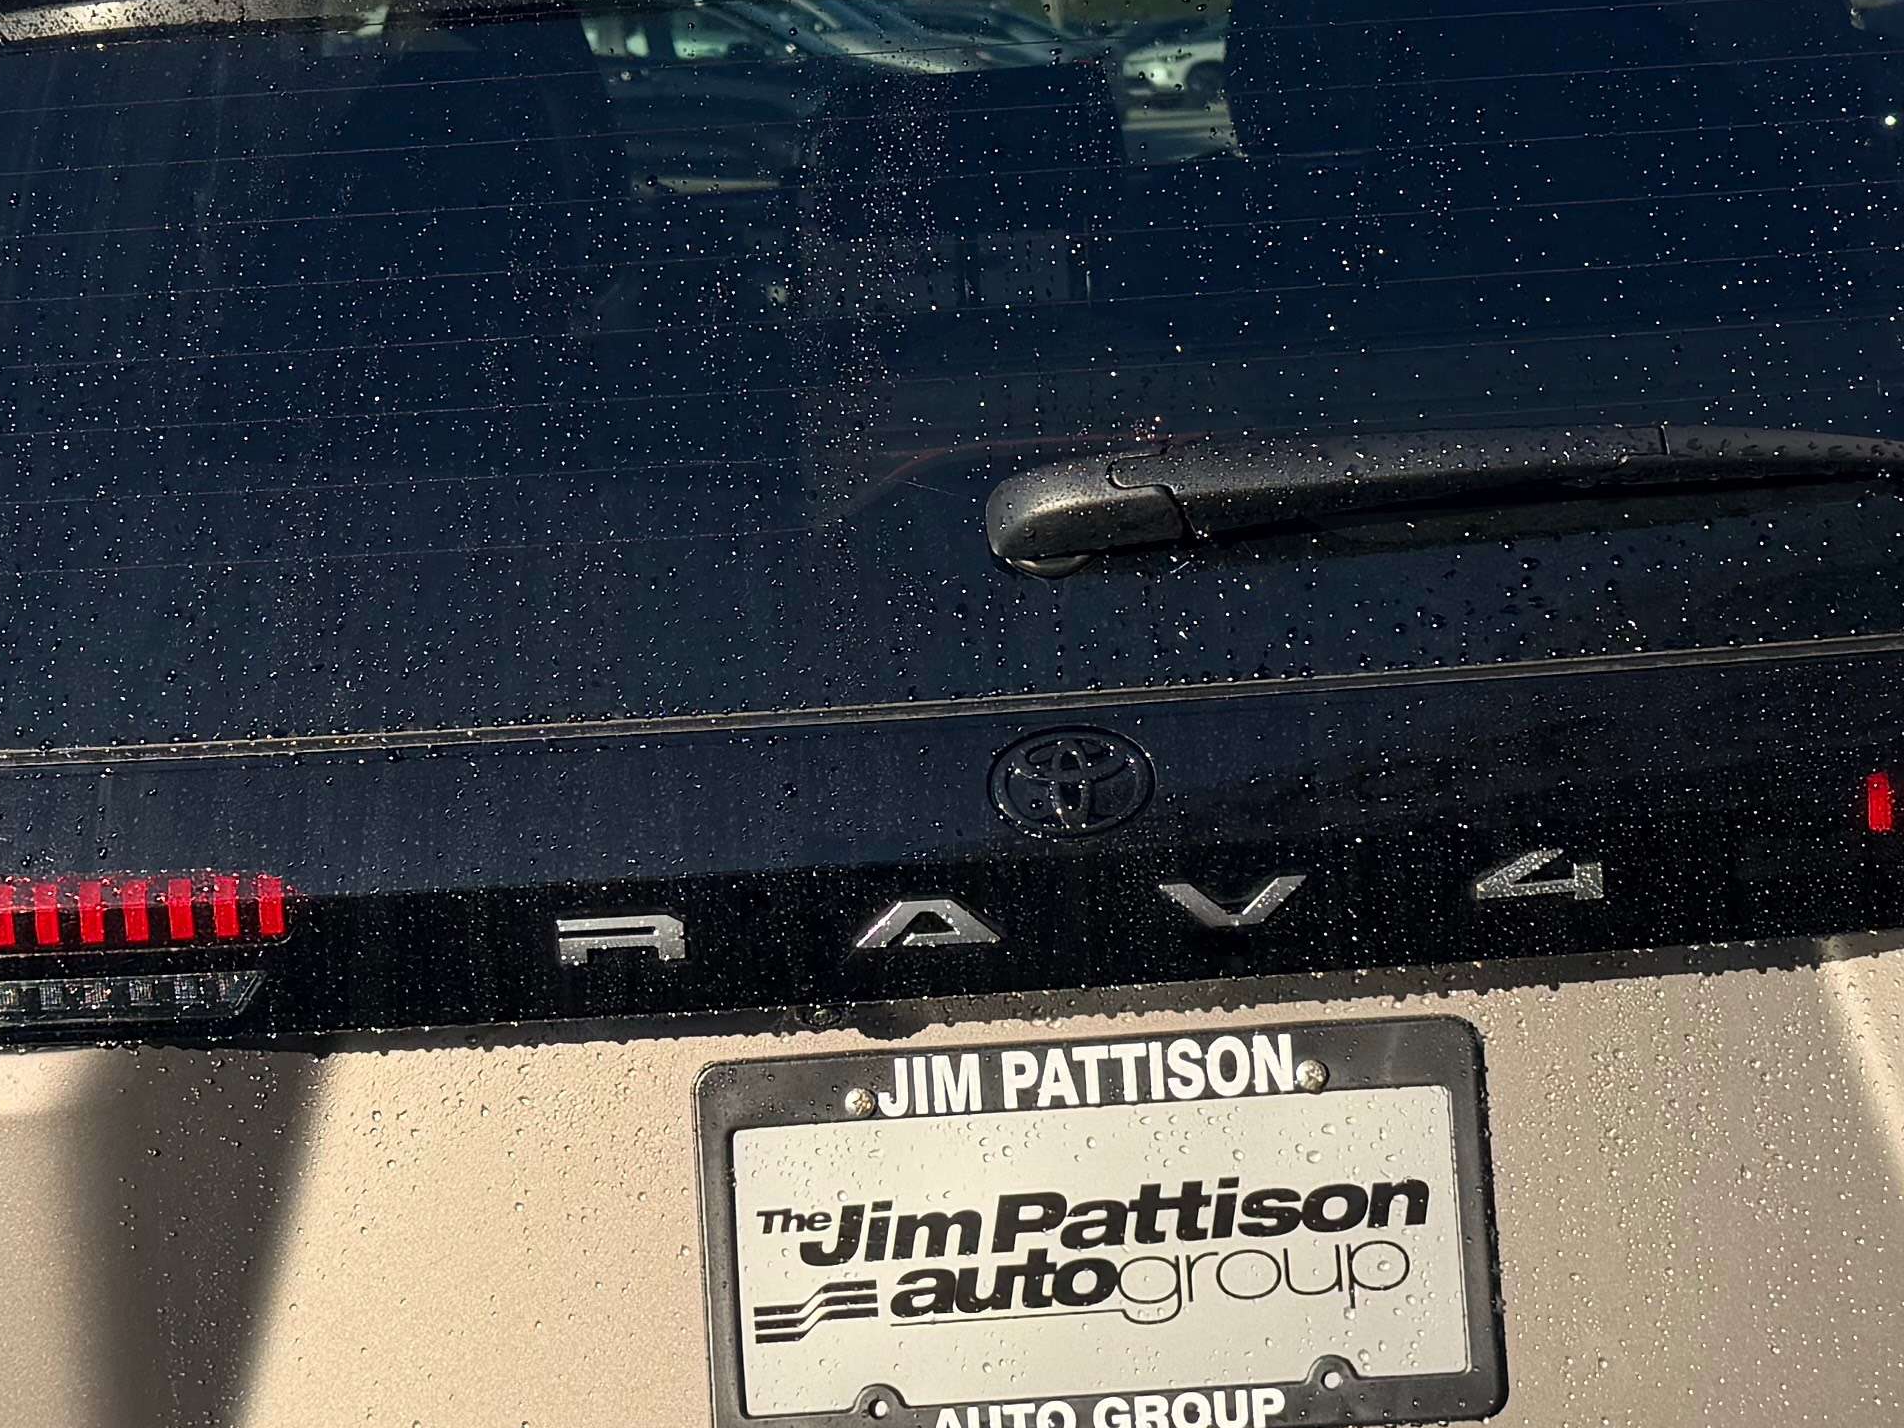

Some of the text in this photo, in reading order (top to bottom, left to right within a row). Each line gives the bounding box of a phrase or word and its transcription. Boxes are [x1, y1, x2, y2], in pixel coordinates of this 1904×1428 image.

[554, 847, 1605, 965] RAV4
[878, 1033, 1294, 1119] JIM PATTISON
[756, 1176, 1430, 1267] The Jim Pattison
[890, 1238, 1410, 1326] autogroup
